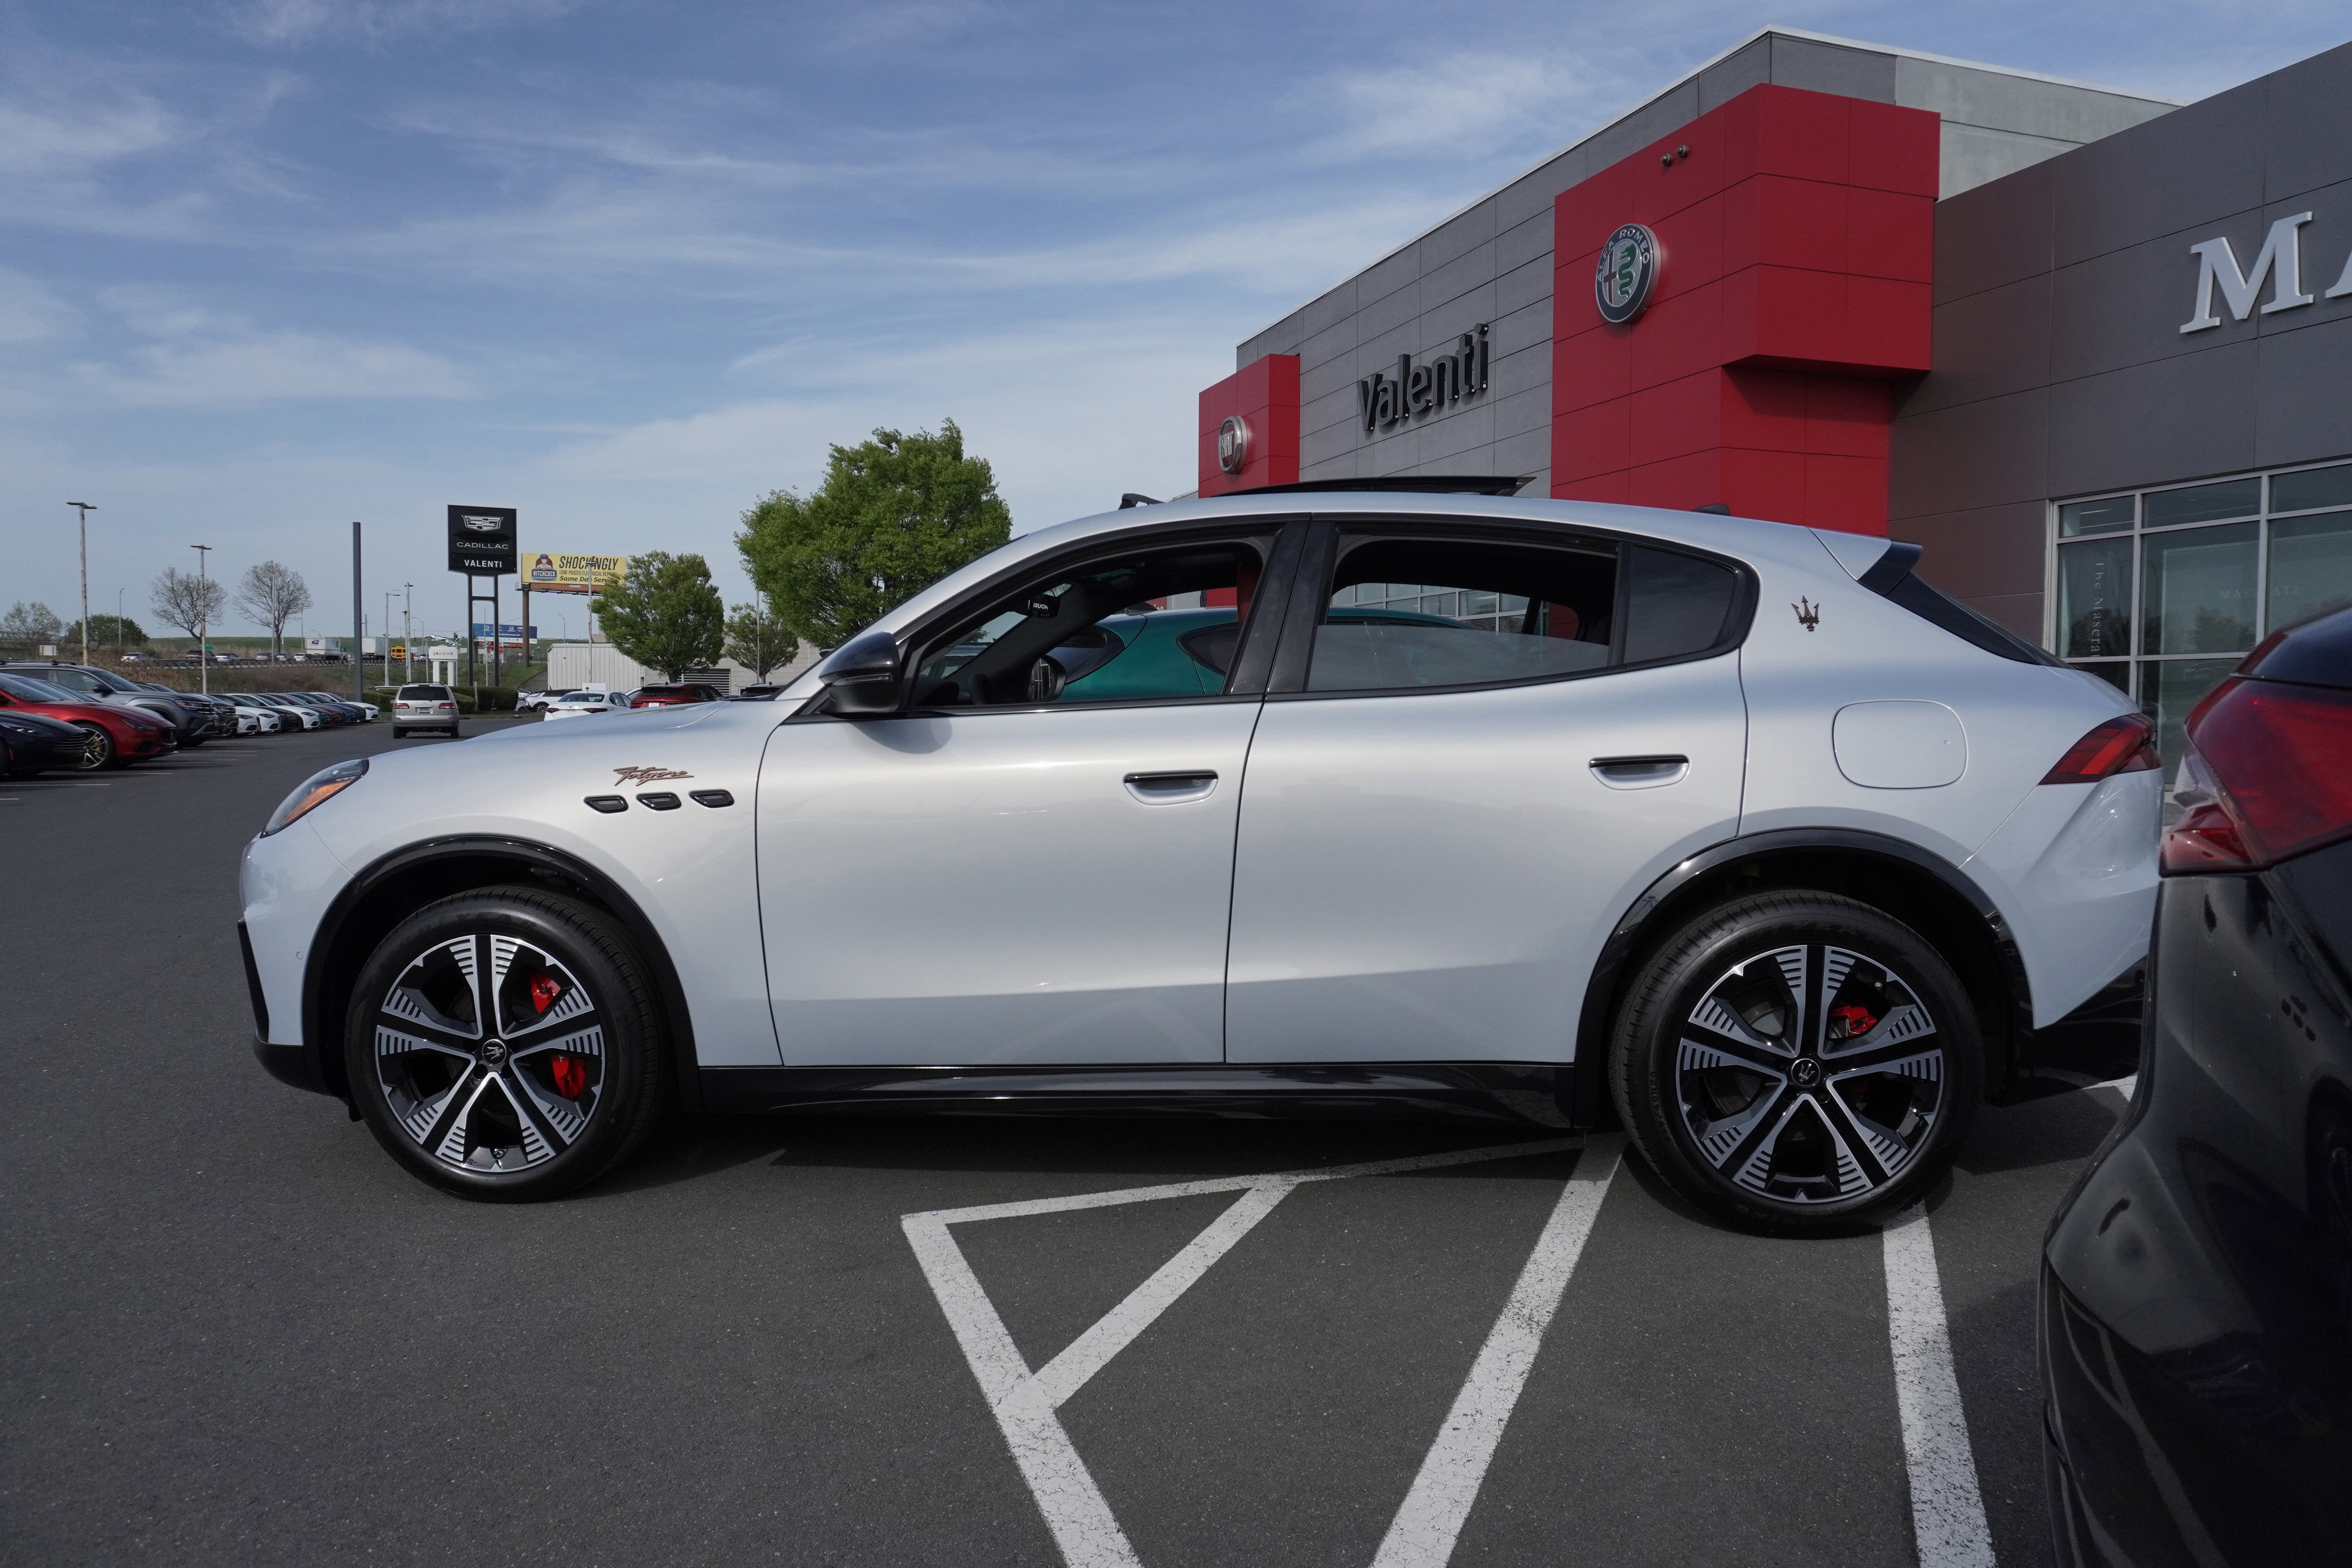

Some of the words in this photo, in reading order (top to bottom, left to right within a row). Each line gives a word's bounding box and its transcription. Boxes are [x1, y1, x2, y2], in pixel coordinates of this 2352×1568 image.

[1597, 241, 1615, 282] ALFA
[1619, 227, 1650, 264] ROMEO
[1356, 323, 1489, 431] Valenti
[1221, 430, 1234, 458] FIAT
[464, 559, 502, 568] VALENTI
[559, 556, 619, 570] SHOCKINGLY
[2095, 559, 2105, 589] The
[612, 766, 694, 786] Folgore
